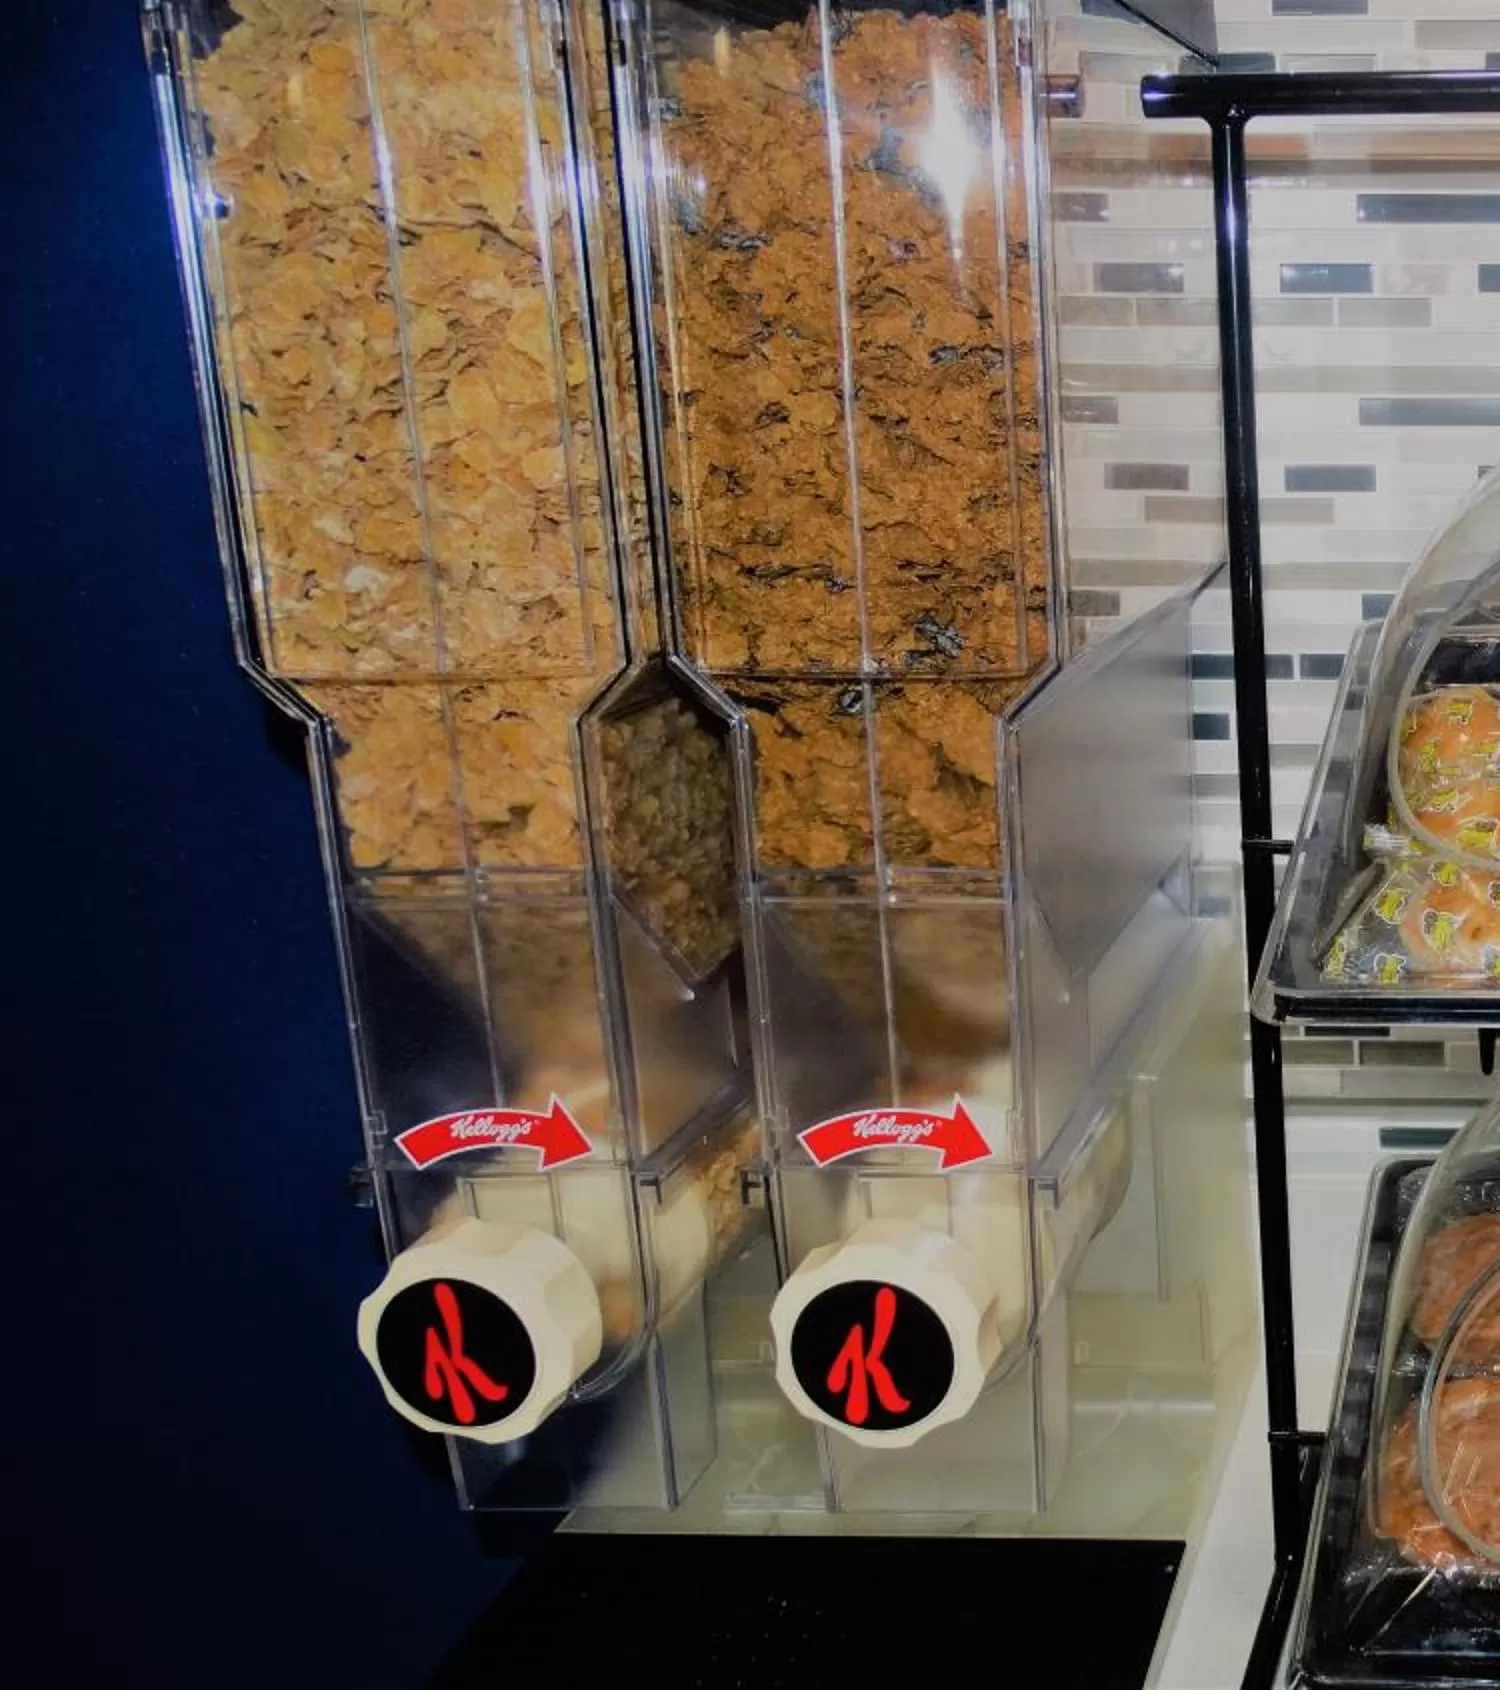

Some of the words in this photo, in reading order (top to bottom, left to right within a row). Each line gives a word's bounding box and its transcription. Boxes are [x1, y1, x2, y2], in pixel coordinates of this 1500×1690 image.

[450, 1115, 532, 1144] Kellogg's
[853, 1113, 934, 1144] Kellogg's
[425, 1283, 508, 1424] K
[827, 1287, 911, 1425] K
